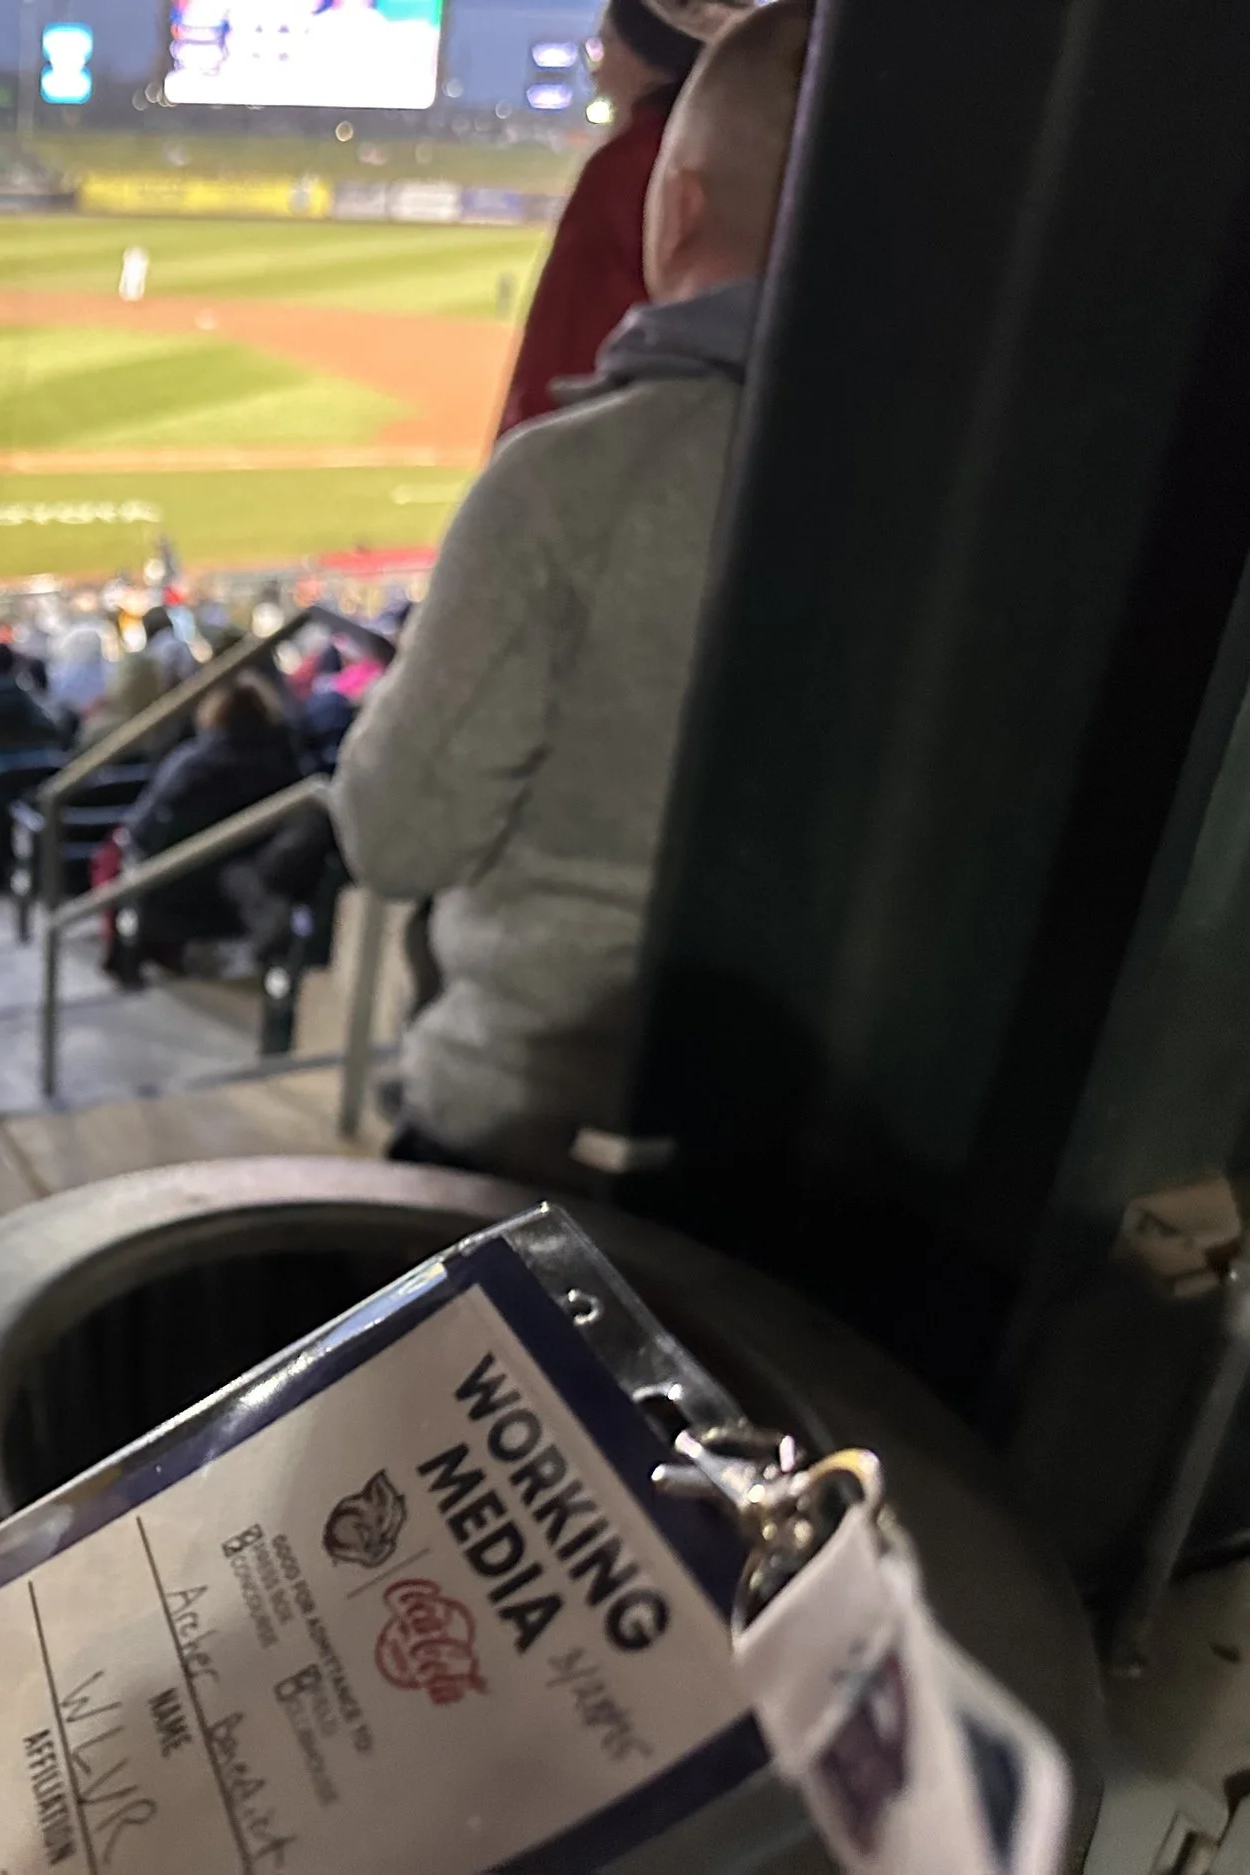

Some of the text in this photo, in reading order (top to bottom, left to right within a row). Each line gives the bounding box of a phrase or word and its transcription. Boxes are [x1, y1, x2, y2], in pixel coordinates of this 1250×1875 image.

[416, 1443, 562, 1654] MEDIA
[455, 1351, 669, 1652] WORKING
[164, 1584, 220, 1684] Archer
[230, 1553, 279, 1648] CONCOURSE
[271, 1533, 301, 1580] GOOD
[293, 1579, 317, 1615] FOR
[307, 1616, 362, 1723] ADMITTANCE
[21, 1728, 77, 1867] AFFILIATION
[58, 1670, 158, 1864] WLVR
[148, 1687, 192, 1758] NAME
